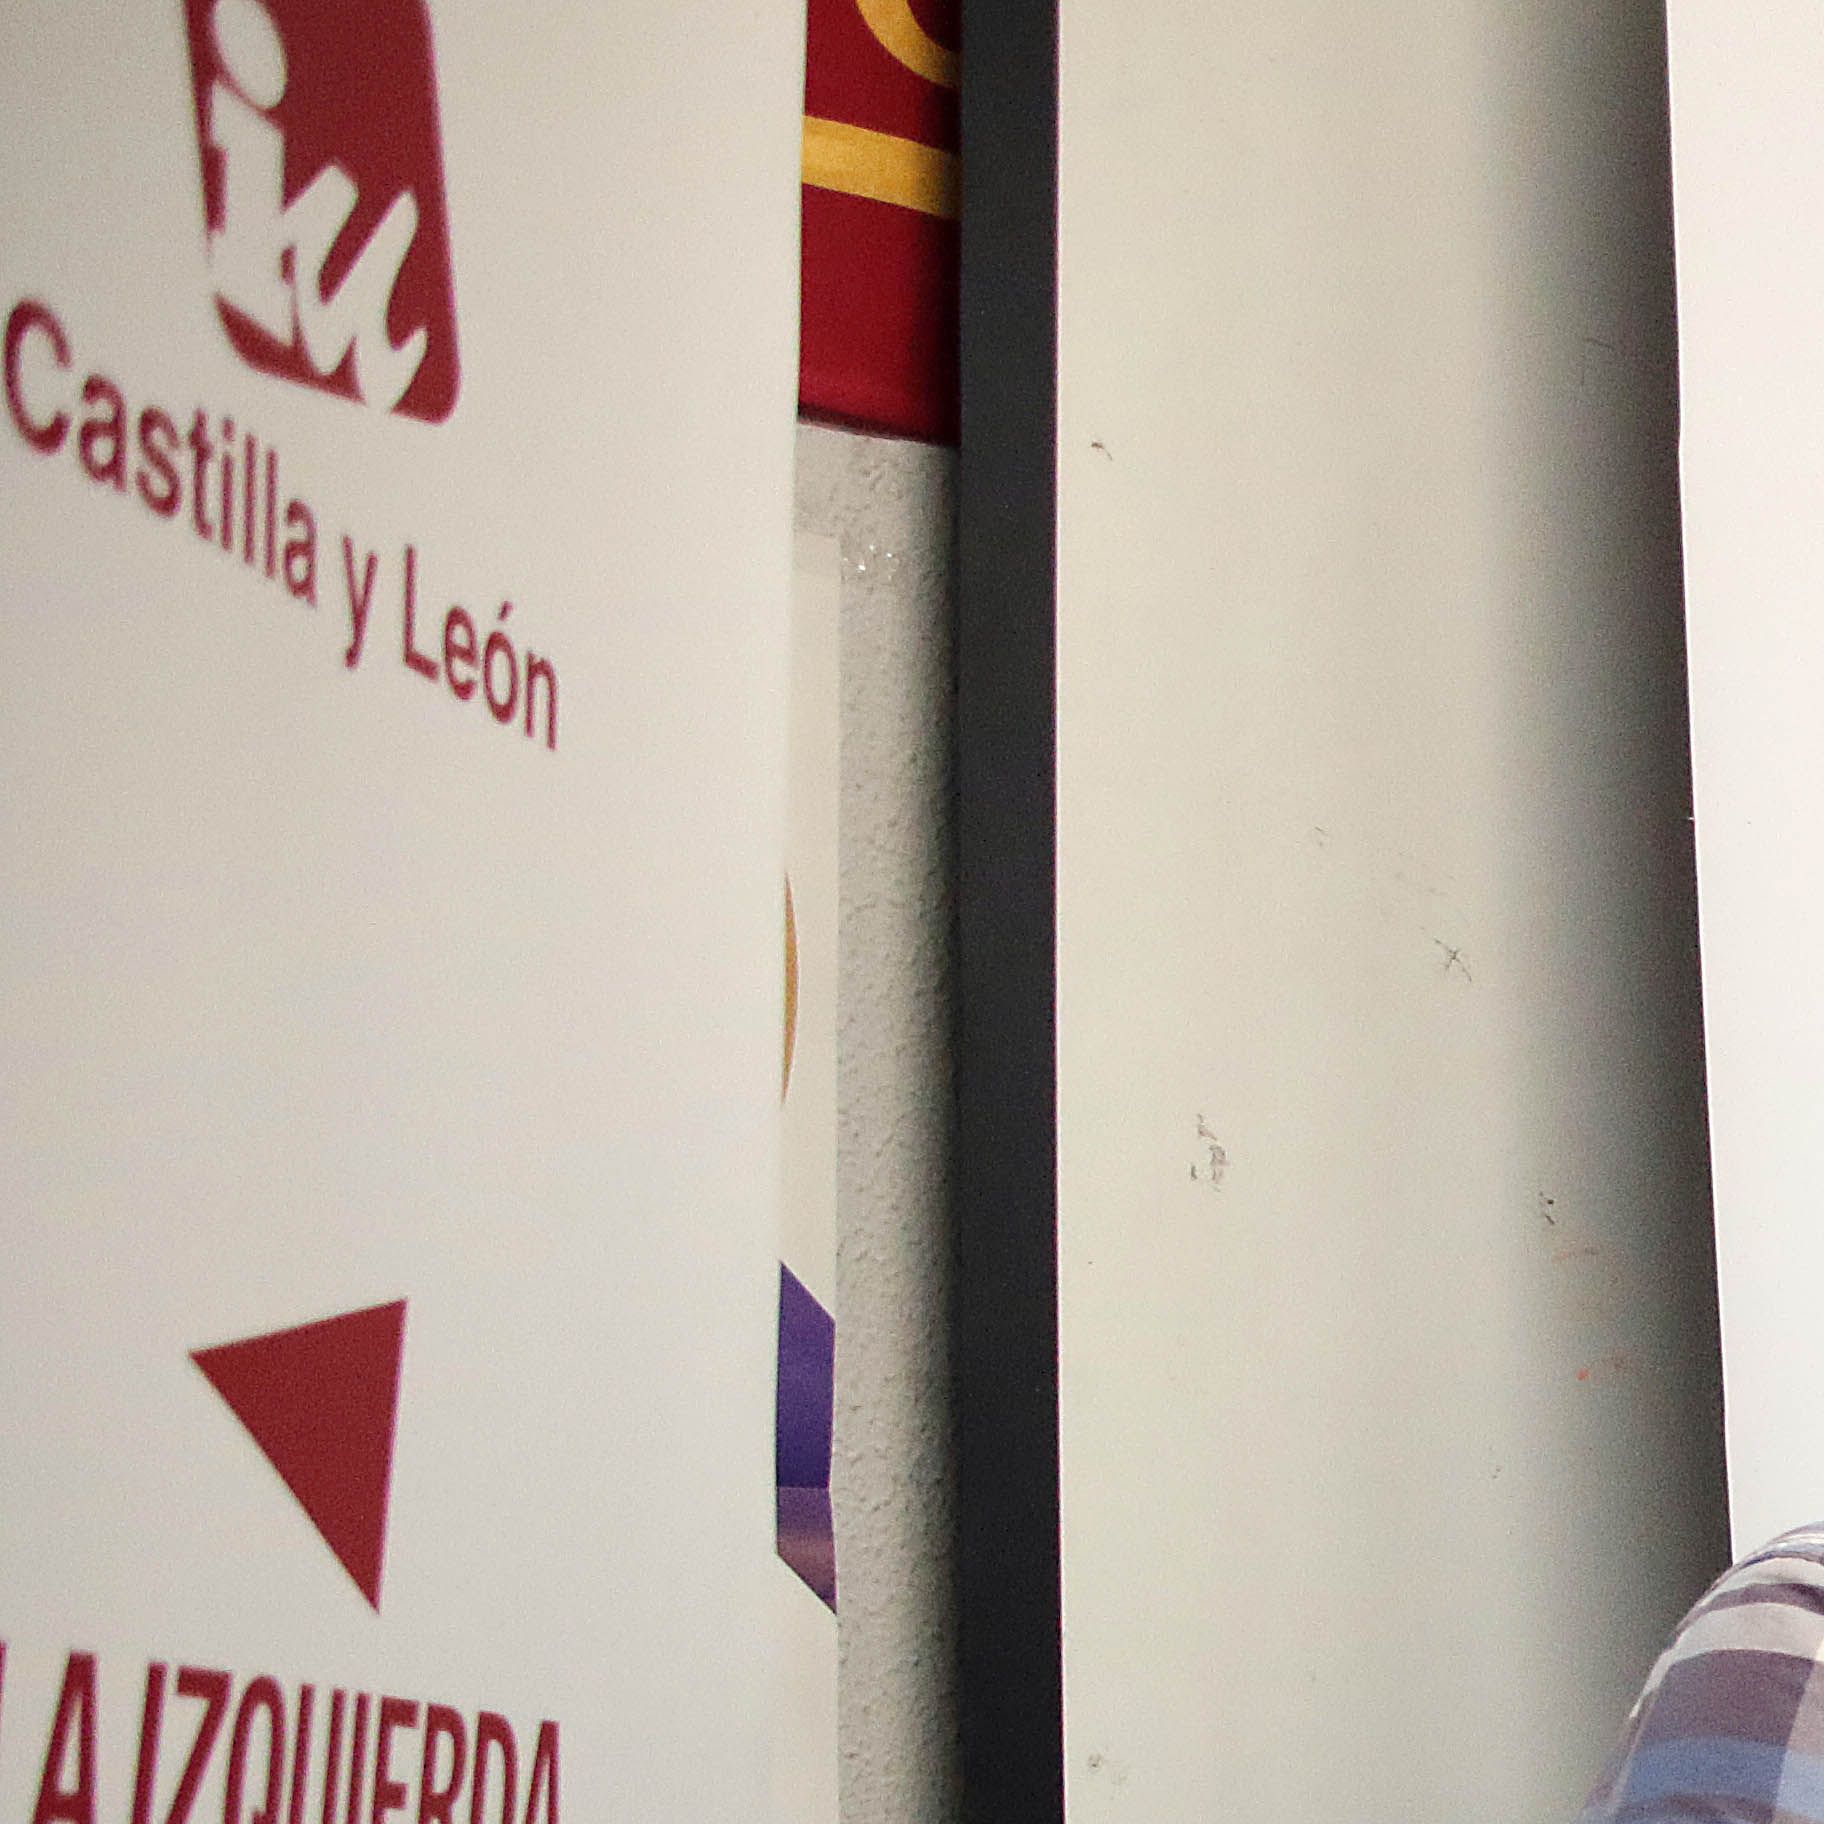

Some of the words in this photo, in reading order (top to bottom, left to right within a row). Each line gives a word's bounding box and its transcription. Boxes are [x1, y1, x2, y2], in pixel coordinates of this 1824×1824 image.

[3, 299, 317, 606] Castilla
[342, 535, 378, 670] y
[402, 545, 559, 751] León
